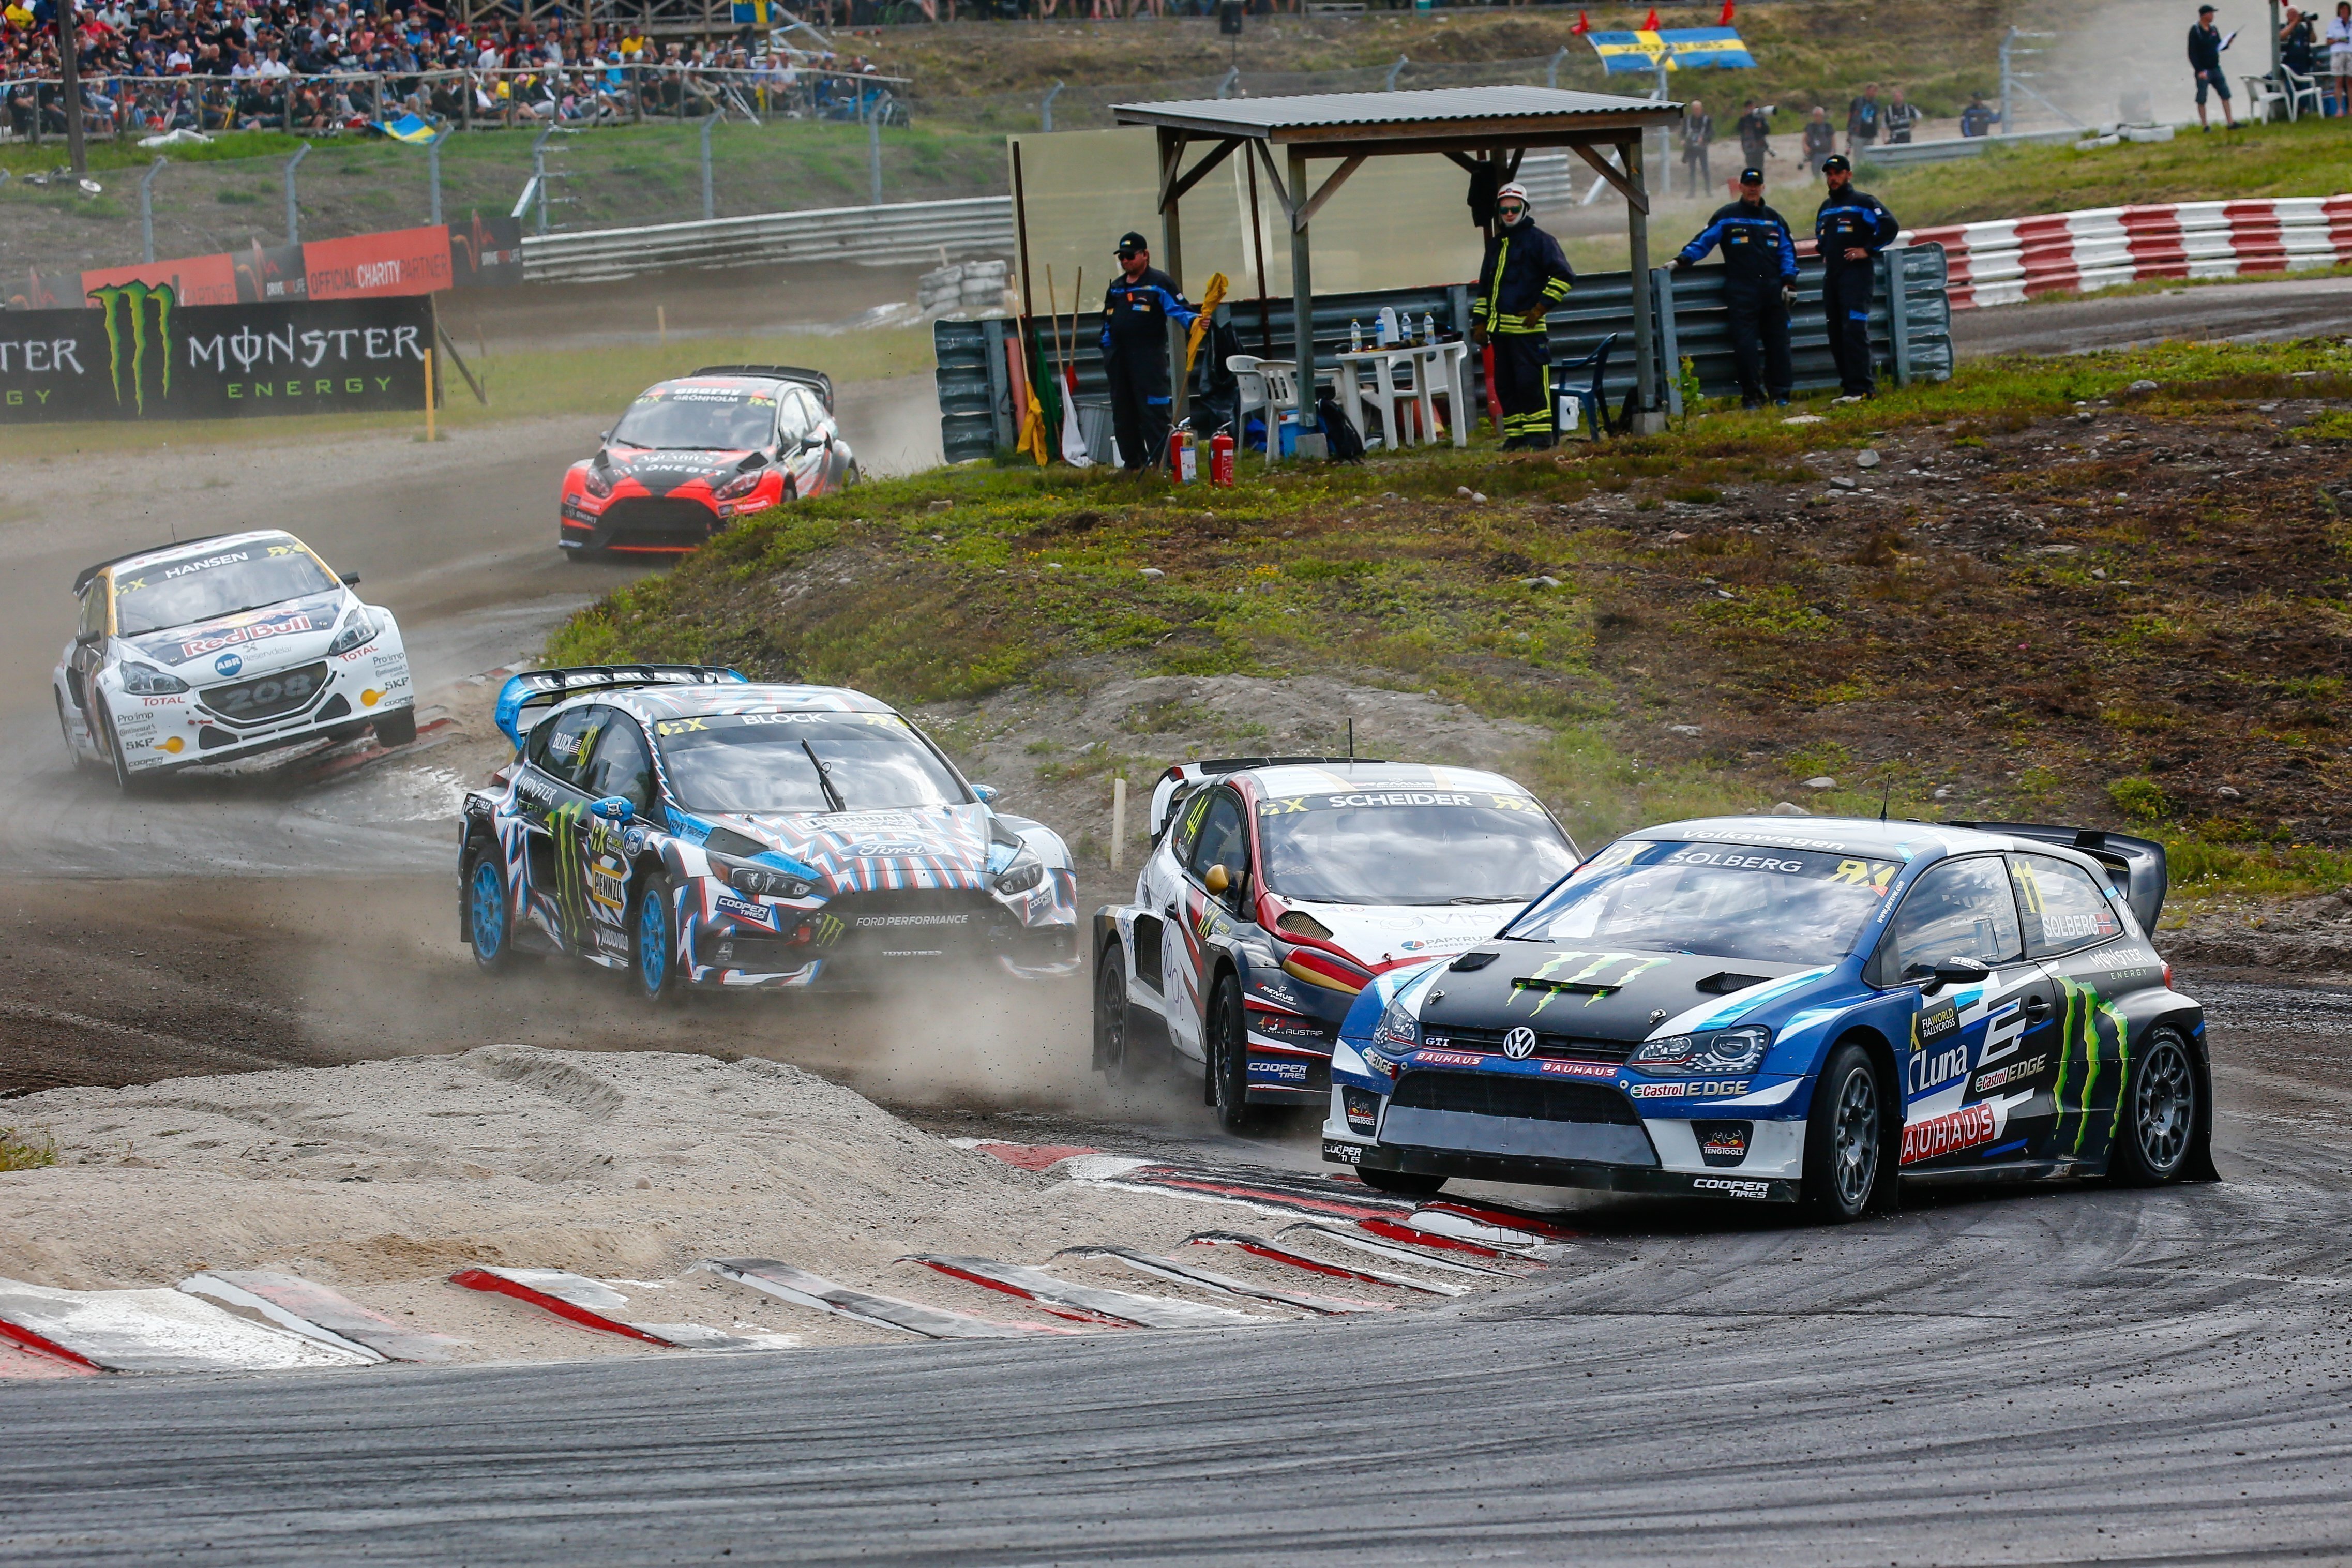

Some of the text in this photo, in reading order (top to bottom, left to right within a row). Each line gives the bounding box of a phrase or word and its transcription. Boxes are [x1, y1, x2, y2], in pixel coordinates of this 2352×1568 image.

[310, 254, 449, 294] OFFICIAL CHARITY PARTNER
[266, 281, 285, 297] DRIVE
[294, 278, 305, 293] LIFE
[188, 323, 426, 373] MONSTER
[227, 376, 391, 399] ENERGY
[165, 552, 249, 579] HANSEN
[182, 615, 312, 658] Red Bull
[243, 646, 292, 662] Reservdelar
[339, 645, 379, 662] TOTAL
[217, 657, 241, 670] ABR
[385, 677, 409, 690] SKF
[225, 674, 312, 711] 208
[142, 696, 185, 706] TOTAL
[385, 695, 414, 706] COOPER
[741, 713, 829, 725] BLOCK
[126, 737, 154, 750] SKF
[552, 732, 574, 752] BLOCK
[128, 756, 163, 767] COOPER
[518, 775, 557, 805] MONSTER
[476, 800, 491, 810] FORZA
[1328, 793, 1473, 807] SCHEIDER
[1184, 795, 1209, 845] 44
[686, 825, 708, 838] TIRES
[626, 832, 640, 852] Ford
[1682, 830, 1846, 850] Volkswagen
[858, 843, 924, 856] Ford
[1668, 852, 1803, 873] SOLBERG
[2011, 861, 2046, 913] 11
[719, 898, 768, 914] COOPER
[1030, 890, 1051, 909] COOPER
[1877, 880, 1905, 923] www.psrxvw.com
[741, 909, 765, 919] TIRES
[856, 915, 969, 926] FORD PERFORMANCE
[2043, 914, 2100, 938] SOLBERG
[1425, 936, 1491, 945] PAPYRUS
[1950, 956, 1980, 968] OMP
[2088, 947, 2149, 969] MONSTER
[2110, 967, 2147, 981] ENERGY
[1261, 986, 1294, 1002] REMUS
[1923, 1018, 1955, 1038] RALLYCROSS
[1426, 1037, 1450, 1046] GTI
[1371, 1053, 1395, 1076] EDGE
[1415, 1052, 1482, 1065] BAUHAUS
[1248, 1062, 1307, 1074] COOPER
[1543, 1063, 1616, 1077] BAUHAUS
[1982, 1053, 2047, 1089] Castrol EDGE
[1278, 1072, 1306, 1080] TIRES
[1643, 1081, 1750, 1096] Castrol EDGE
[1341, 1154, 1360, 1163] TIES
[1693, 1179, 1769, 1192] COOPER
[1729, 1190, 1767, 1198] TIRES
